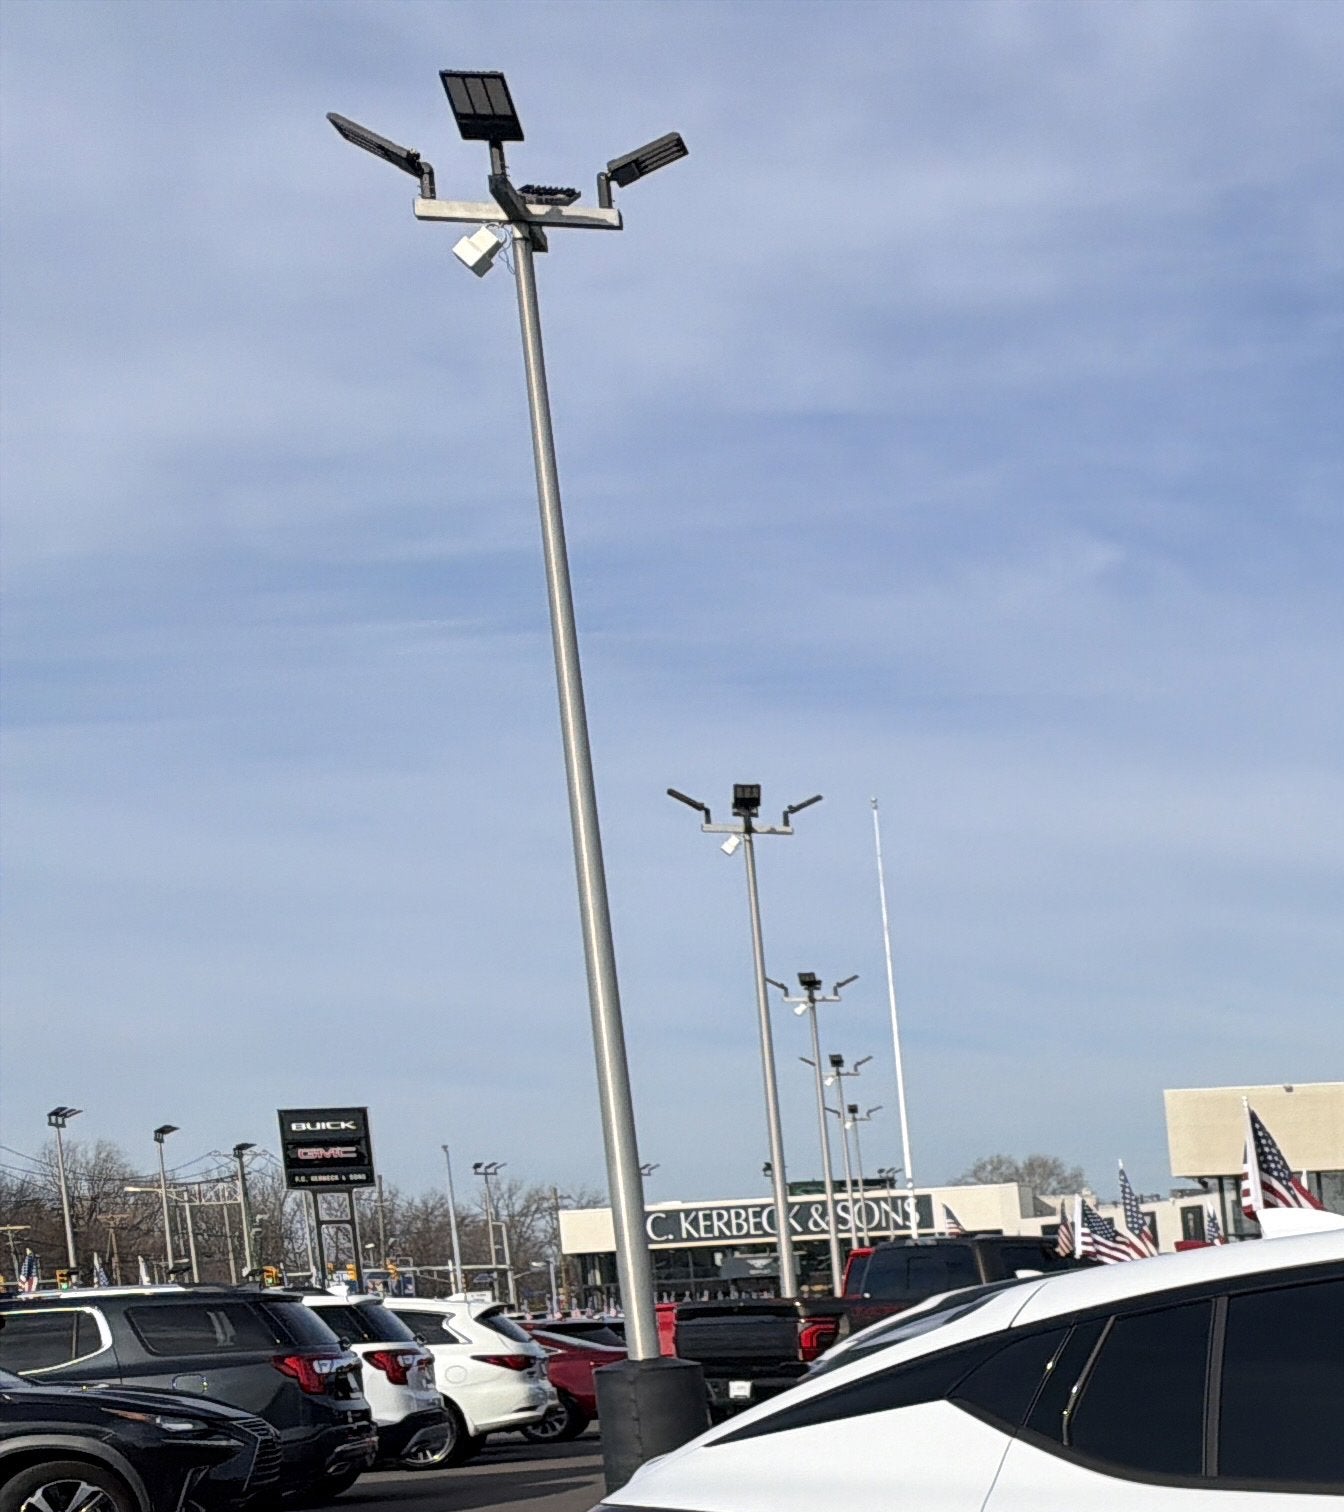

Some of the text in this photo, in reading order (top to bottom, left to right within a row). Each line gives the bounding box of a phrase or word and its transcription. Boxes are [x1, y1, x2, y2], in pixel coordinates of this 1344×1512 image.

[291, 1121, 357, 1131] BUICK
[297, 1146, 358, 1160] GMC
[680, 1202, 804, 1239] KERBECK
[807, 1203, 831, 1232] &
[836, 1197, 920, 1231] SONS
